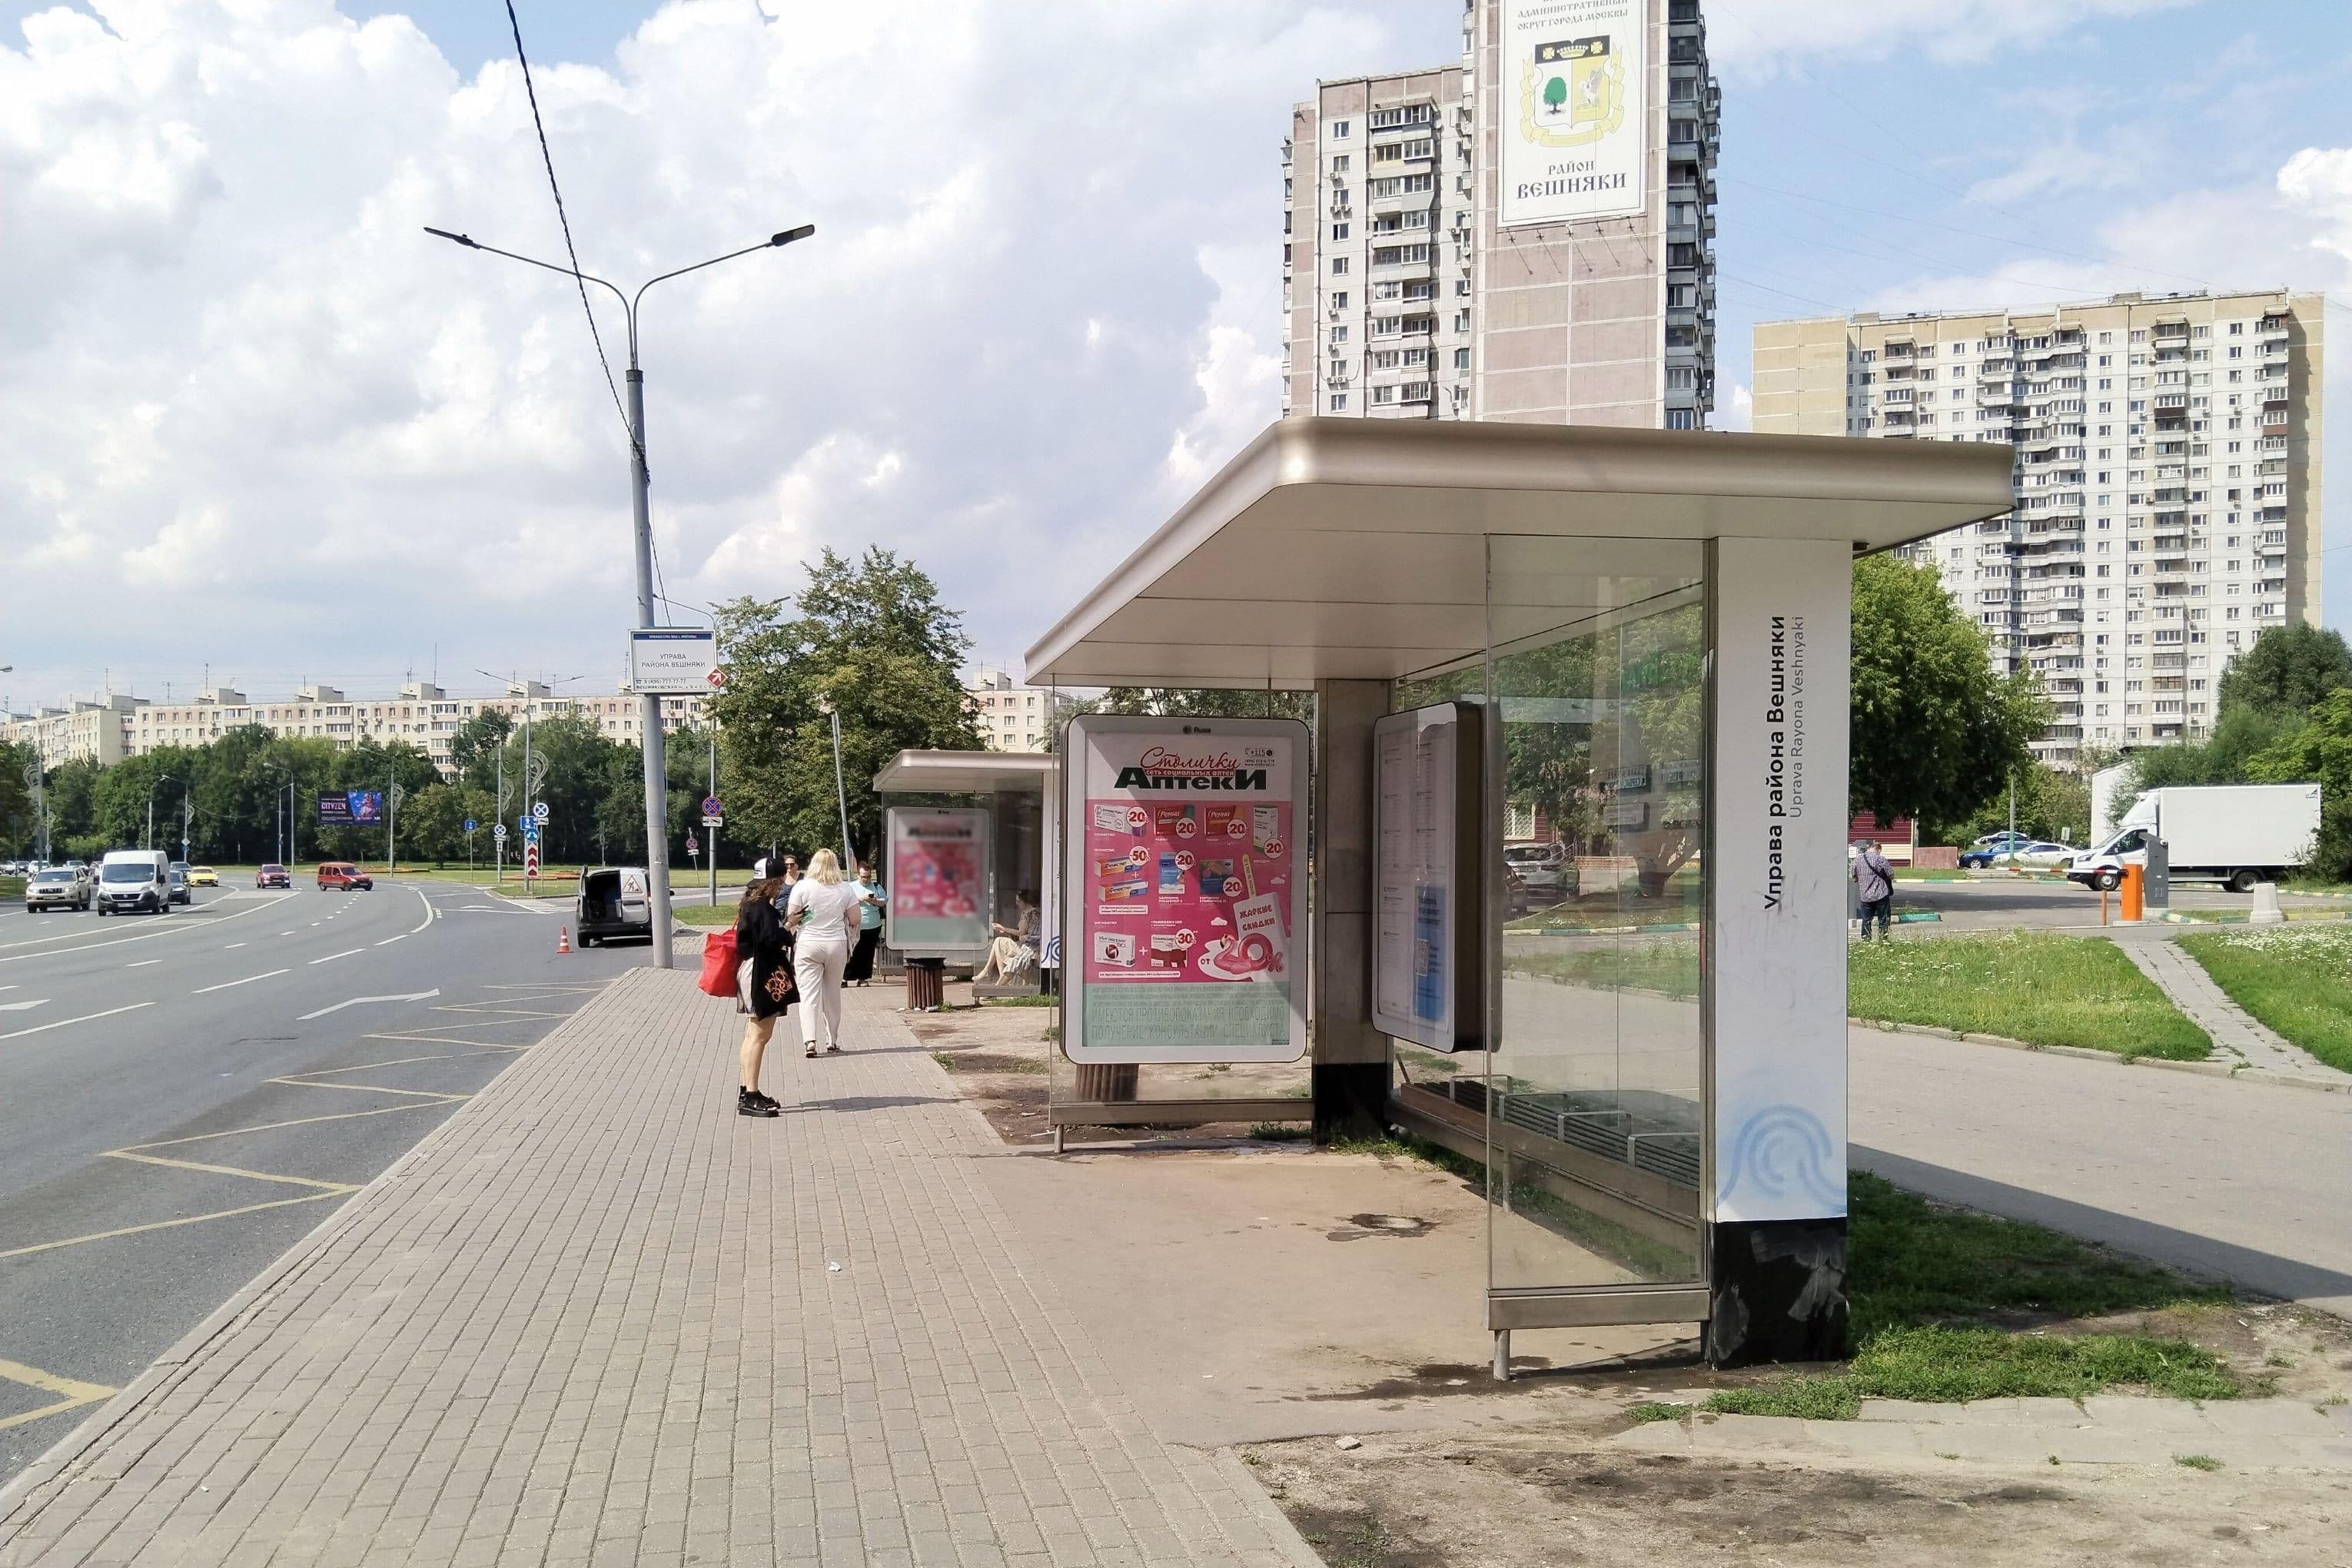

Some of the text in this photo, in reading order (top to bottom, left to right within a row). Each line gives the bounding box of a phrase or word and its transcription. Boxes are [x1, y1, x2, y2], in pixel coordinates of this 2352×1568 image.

[1517, 9, 1628, 30] ОКРУГ ГОРОДА МОСКВЫ
[1548, 160, 1595, 175] РАЙОН
[1516, 172, 1627, 200] ВЕШНЯКИ
[1790, 616, 1806, 818] Uprava Rayona Veshnyaki
[1140, 746, 1241, 769] Столички
[1764, 616, 1786, 910] Управа района Вешняки
[1239, 905, 1273, 919] ЖАРКИЕ
[1242, 918, 1275, 932] СКИДКИ
